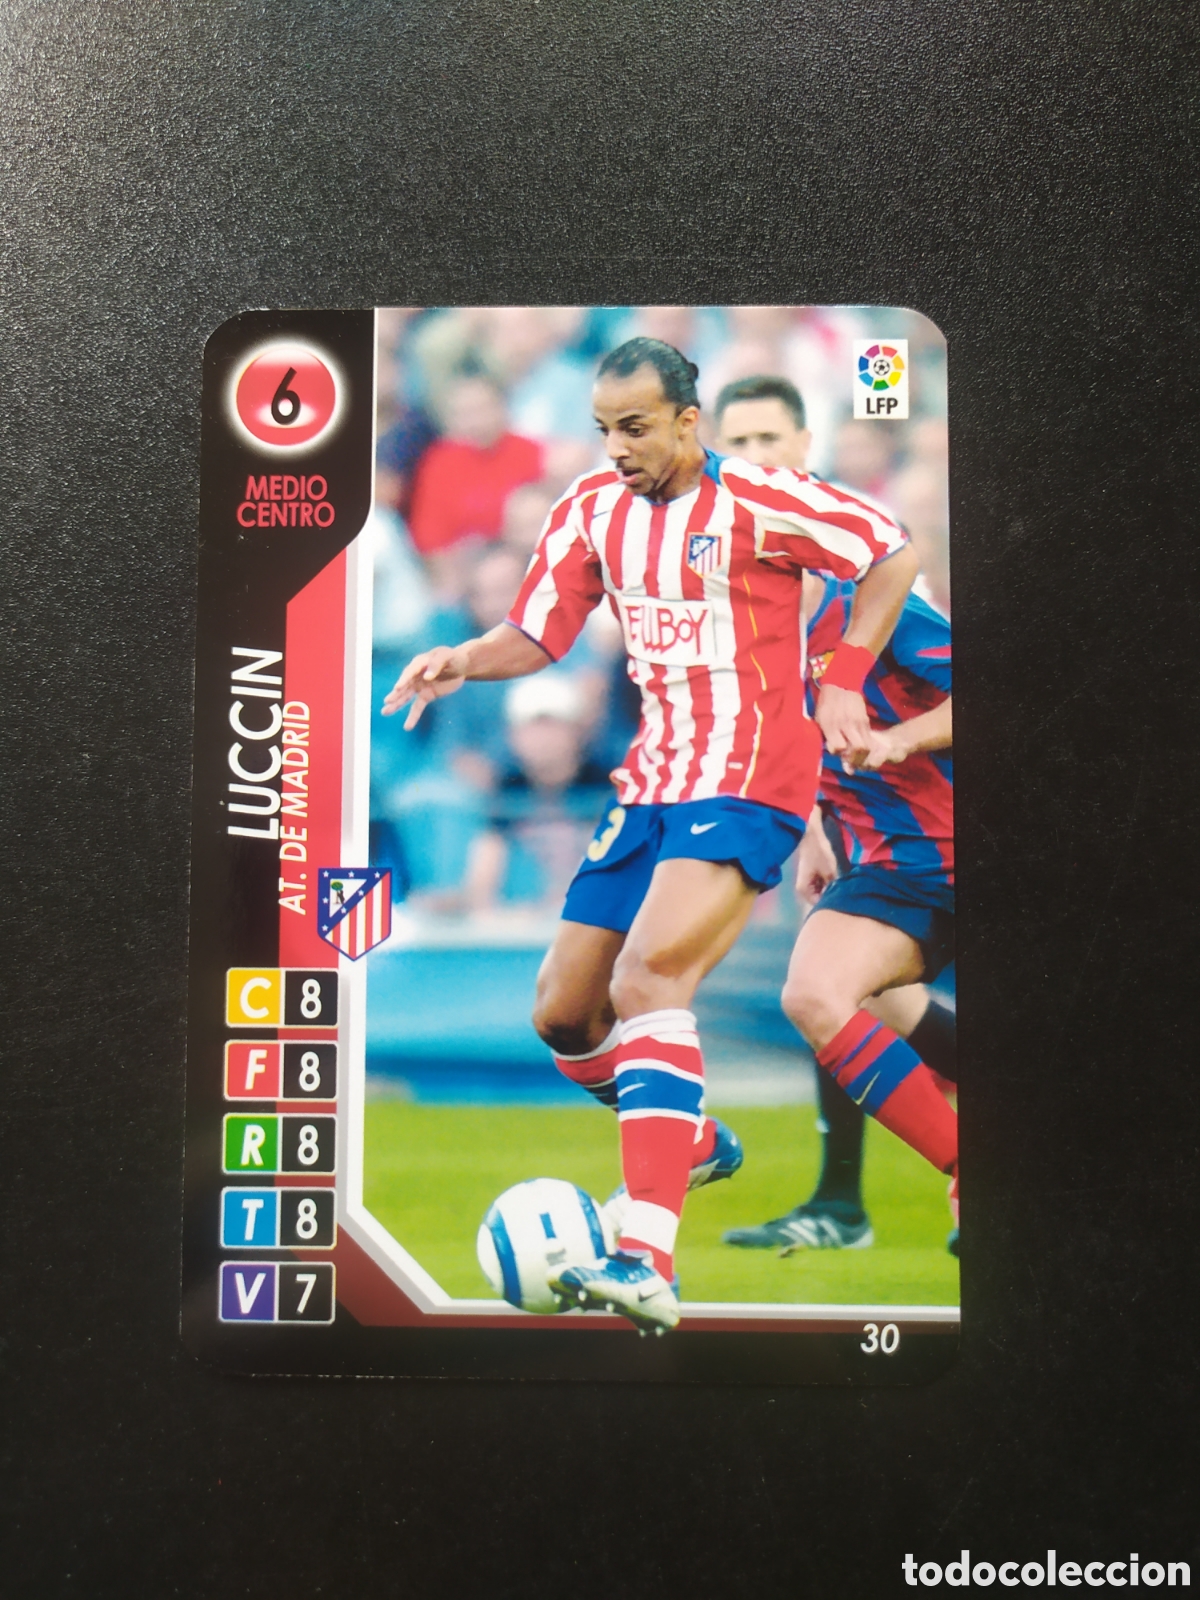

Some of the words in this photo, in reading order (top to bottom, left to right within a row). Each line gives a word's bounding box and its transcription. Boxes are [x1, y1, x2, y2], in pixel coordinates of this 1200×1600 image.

[271, 367, 301, 425] 6
[866, 397, 898, 414] LFP
[245, 474, 328, 500] MEDIO
[236, 502, 336, 528] CENTRO
[227, 646, 283, 840] LUCCIN
[280, 700, 311, 818] MADRID
[279, 824, 308, 862] DE
[278, 872, 307, 915] AT.
[240, 977, 272, 1019] C
[300, 978, 322, 1019] 8
[244, 1049, 268, 1091] F
[298, 1051, 321, 1092] 8
[240, 1124, 266, 1166] R
[297, 1124, 320, 1166] 8
[242, 1198, 264, 1241] T
[296, 1198, 318, 1240] 8
[234, 1272, 266, 1315] V
[295, 1273, 317, 1314] 7
[860, 1323, 901, 1353] 30
